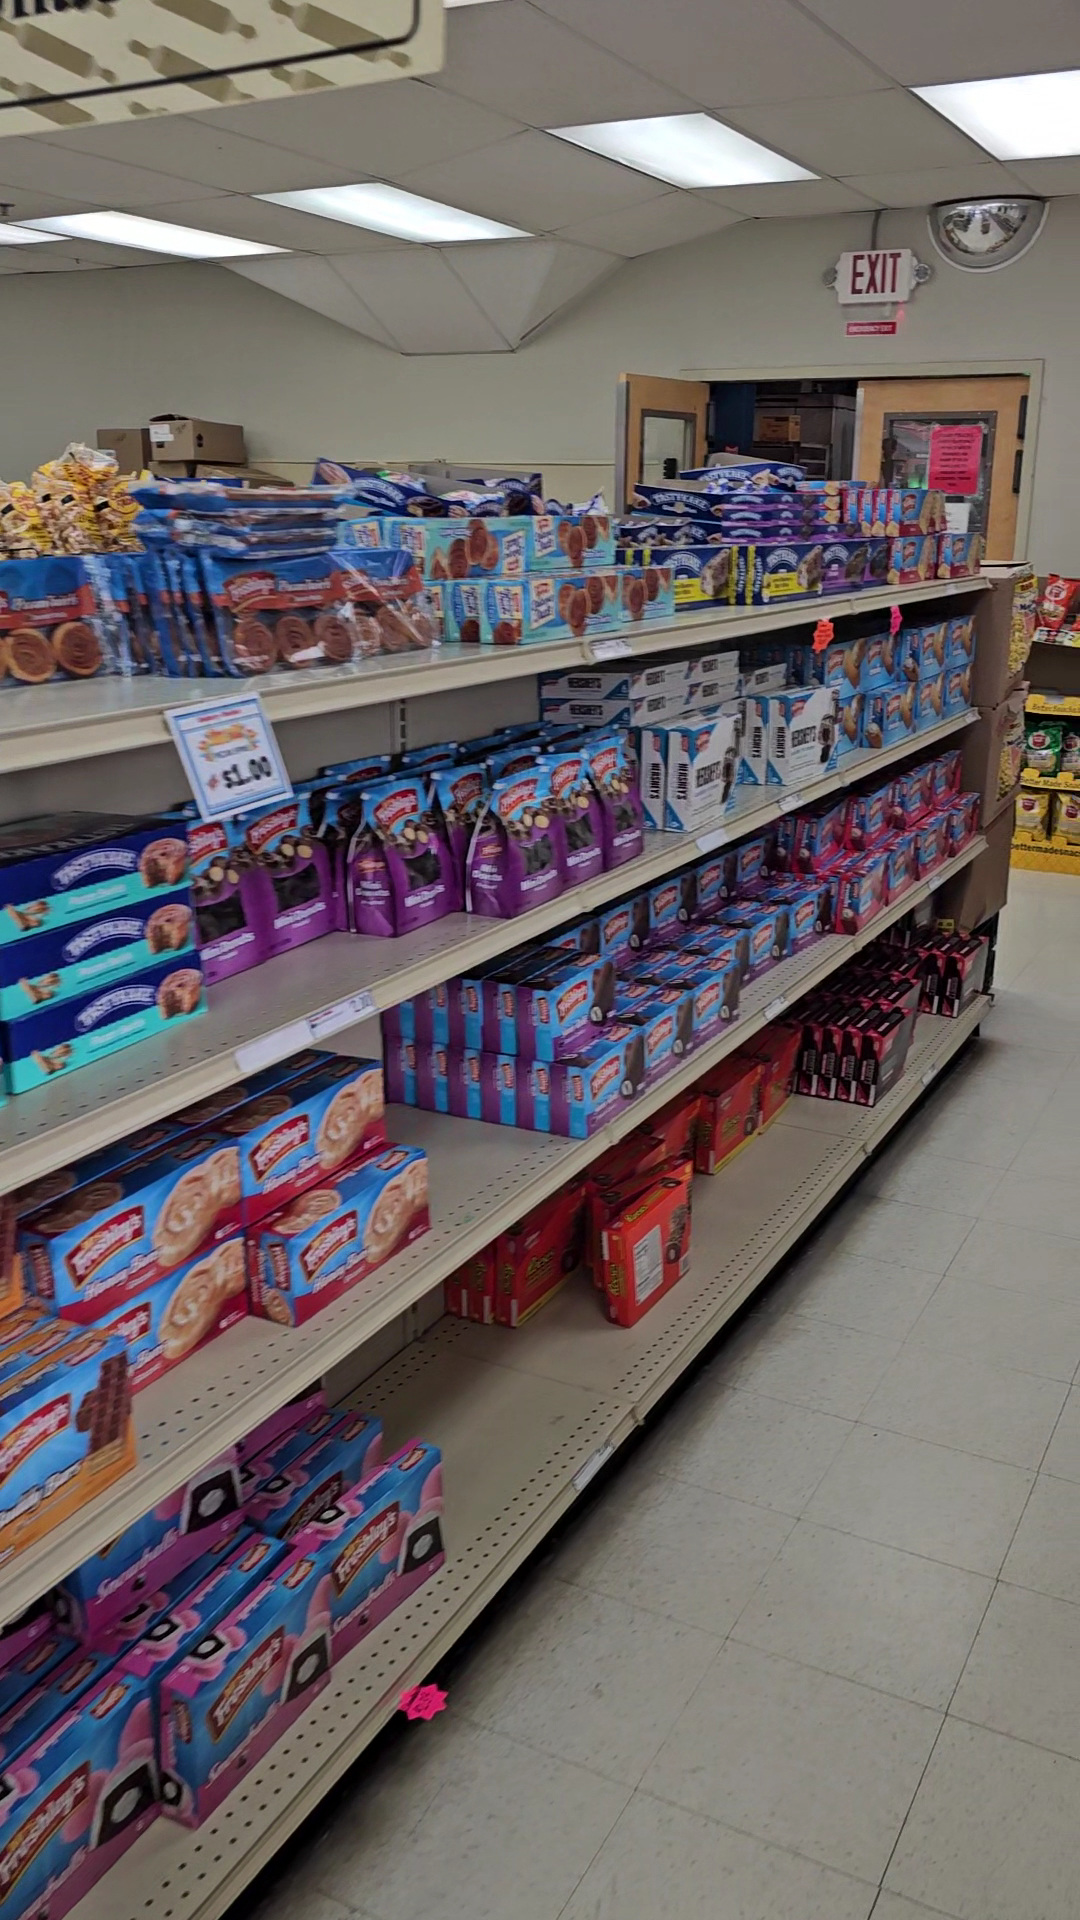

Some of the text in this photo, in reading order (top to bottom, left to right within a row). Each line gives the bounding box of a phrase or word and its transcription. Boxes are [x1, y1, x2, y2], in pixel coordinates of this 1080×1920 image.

[851, 252, 902, 294] EXIT
[335, 1511, 398, 1583] Freshley's
[213, 1637, 282, 1726] Freshley's
